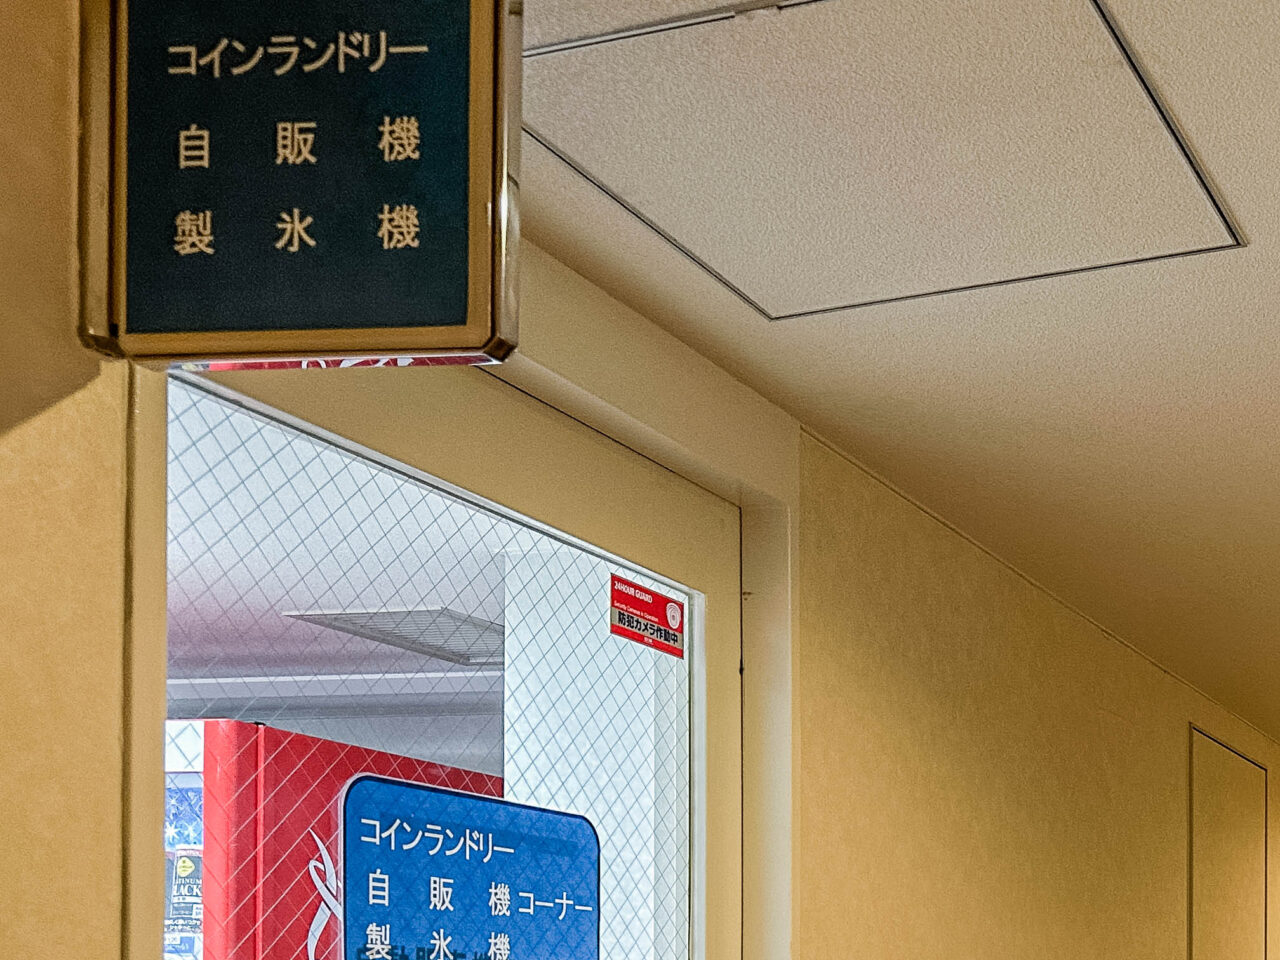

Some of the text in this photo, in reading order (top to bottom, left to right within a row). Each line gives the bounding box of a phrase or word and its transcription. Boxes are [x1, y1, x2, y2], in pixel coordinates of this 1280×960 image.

[167, 31, 429, 77] コインランドリー
[618, 610, 679, 645] 防犯カメラ作動中
[360, 818, 515, 863] コインランドリー
